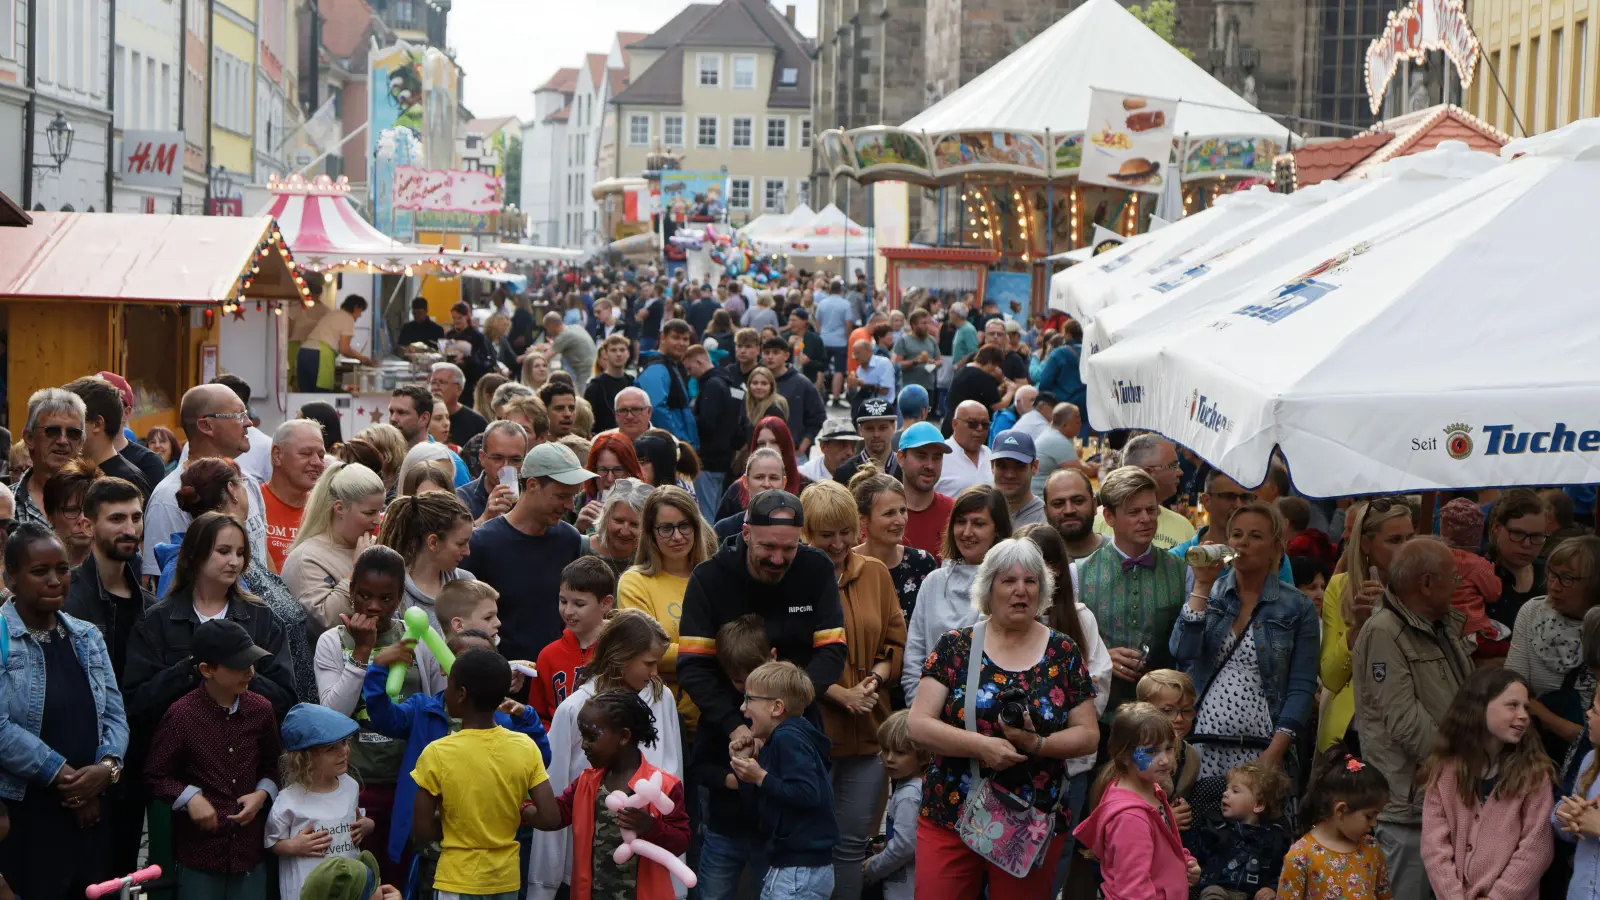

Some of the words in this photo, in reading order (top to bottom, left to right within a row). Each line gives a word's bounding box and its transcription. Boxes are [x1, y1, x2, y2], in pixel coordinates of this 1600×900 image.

[128, 142, 177, 176] H&M
[1411, 438, 1438, 451] Seit
[1482, 422, 1600, 456] Tuche
